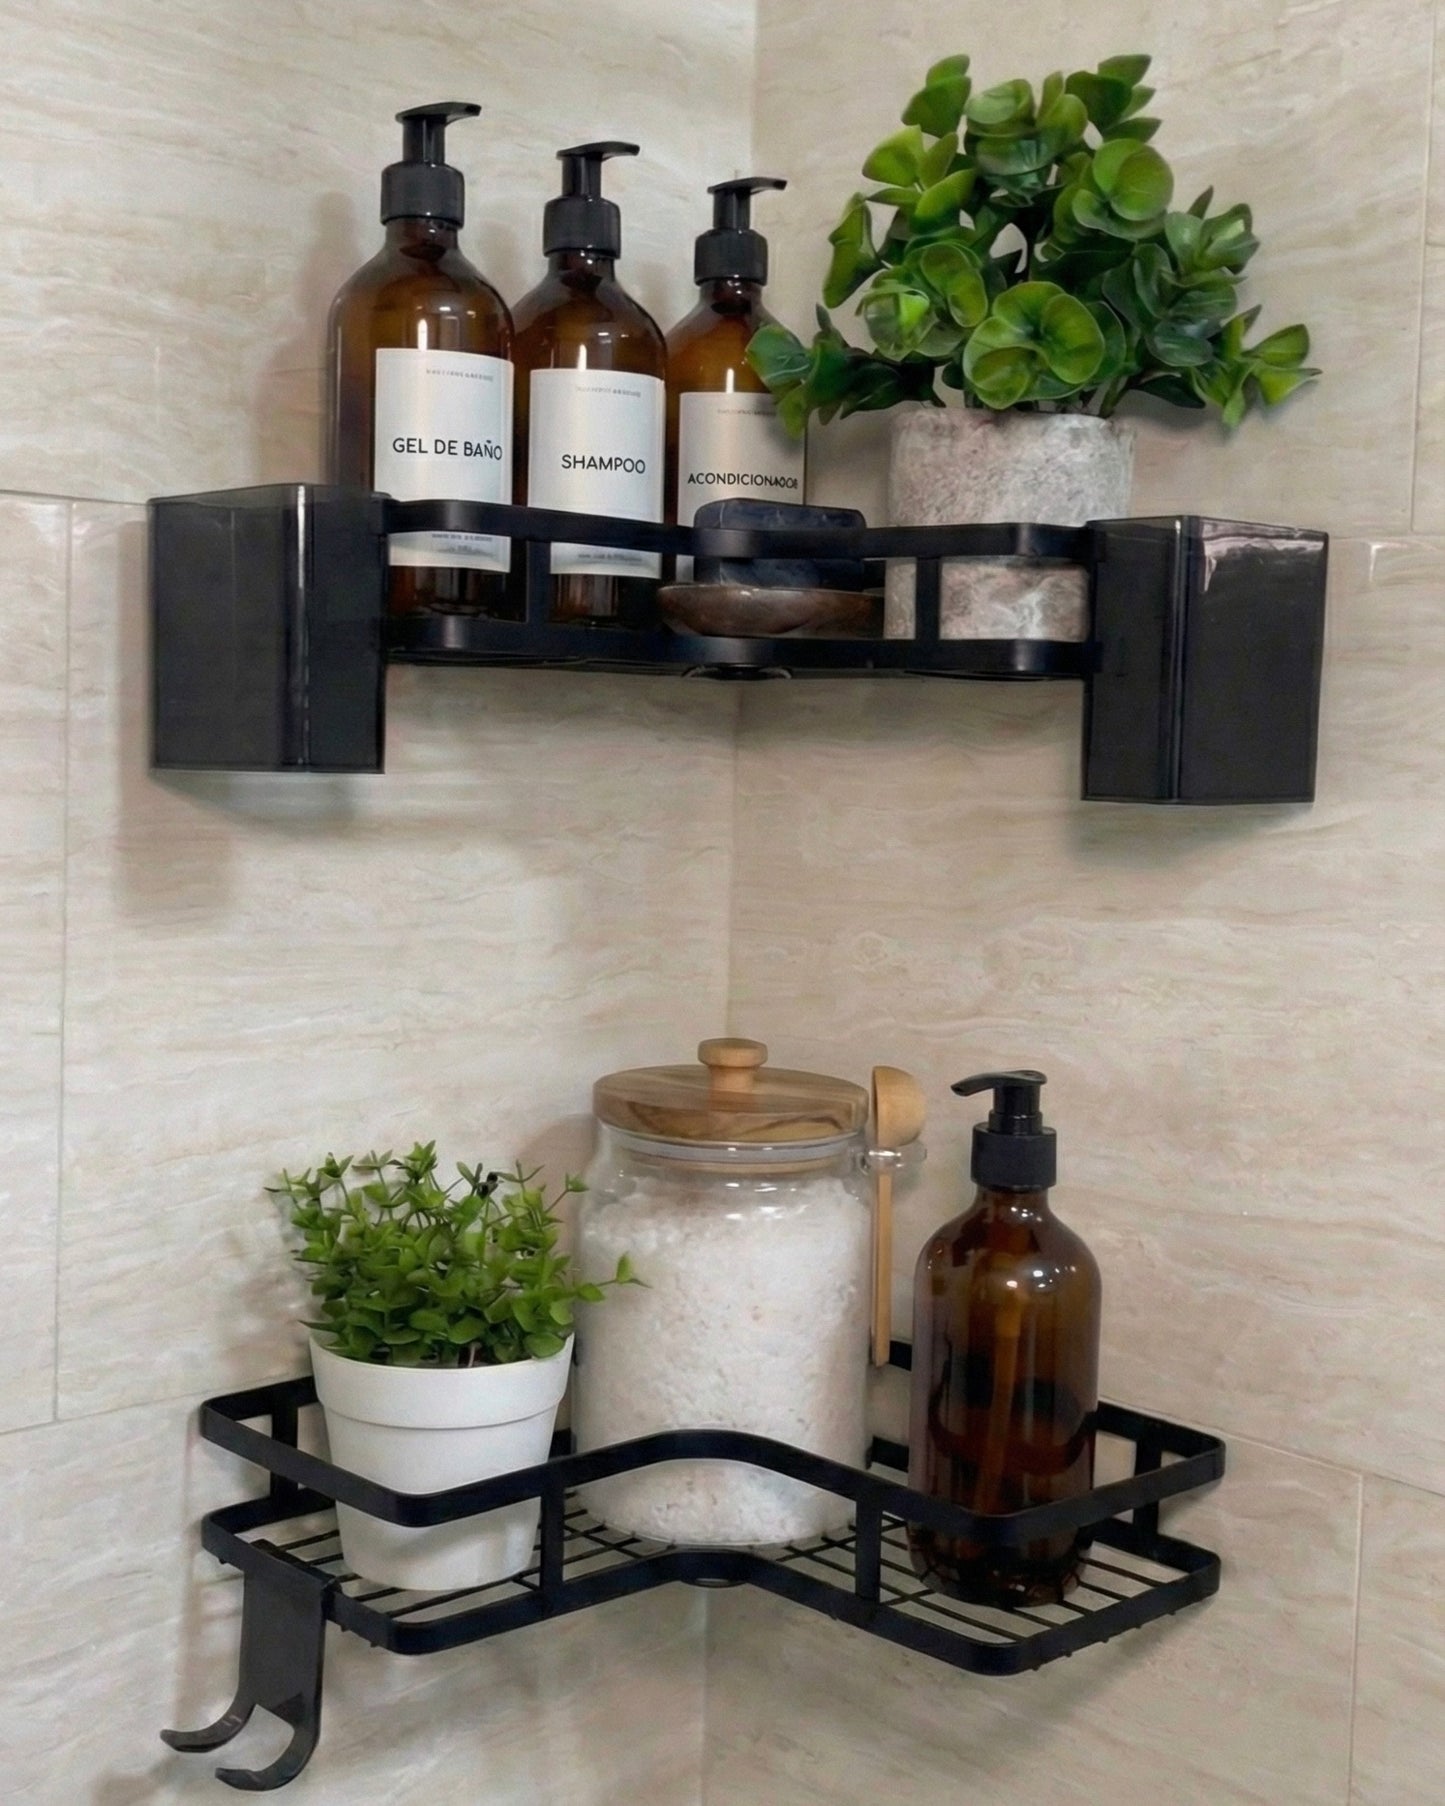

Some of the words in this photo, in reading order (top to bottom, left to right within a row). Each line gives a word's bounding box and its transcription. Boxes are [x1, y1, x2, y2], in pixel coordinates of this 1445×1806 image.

[392, 437, 428, 454] GEL
[434, 439, 458, 456] DE
[463, 440, 502, 461] BAÑO
[561, 454, 646, 474] SHAMPOO
